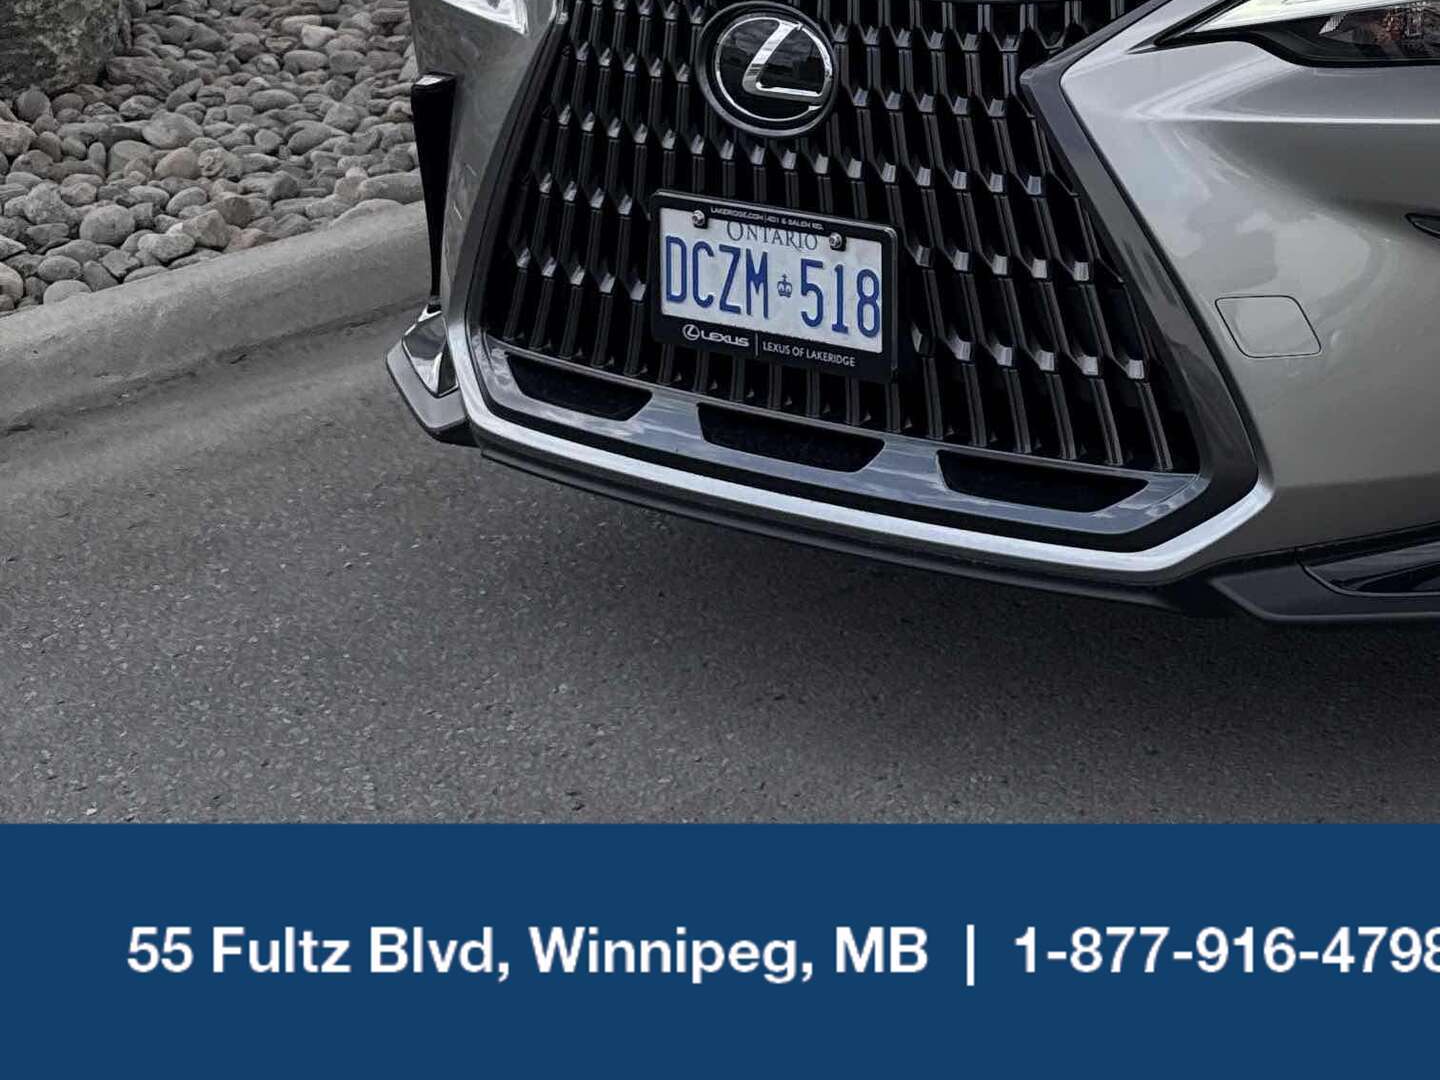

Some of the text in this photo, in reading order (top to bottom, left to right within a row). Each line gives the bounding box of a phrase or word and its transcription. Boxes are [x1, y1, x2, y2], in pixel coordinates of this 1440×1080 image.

[726, 221, 818, 251] ONTARIO
[665, 235, 881, 338] DCZM 518
[701, 329, 750, 347] LEXUS
[762, 340, 856, 367] LEXUS OF LAKERIDGE
